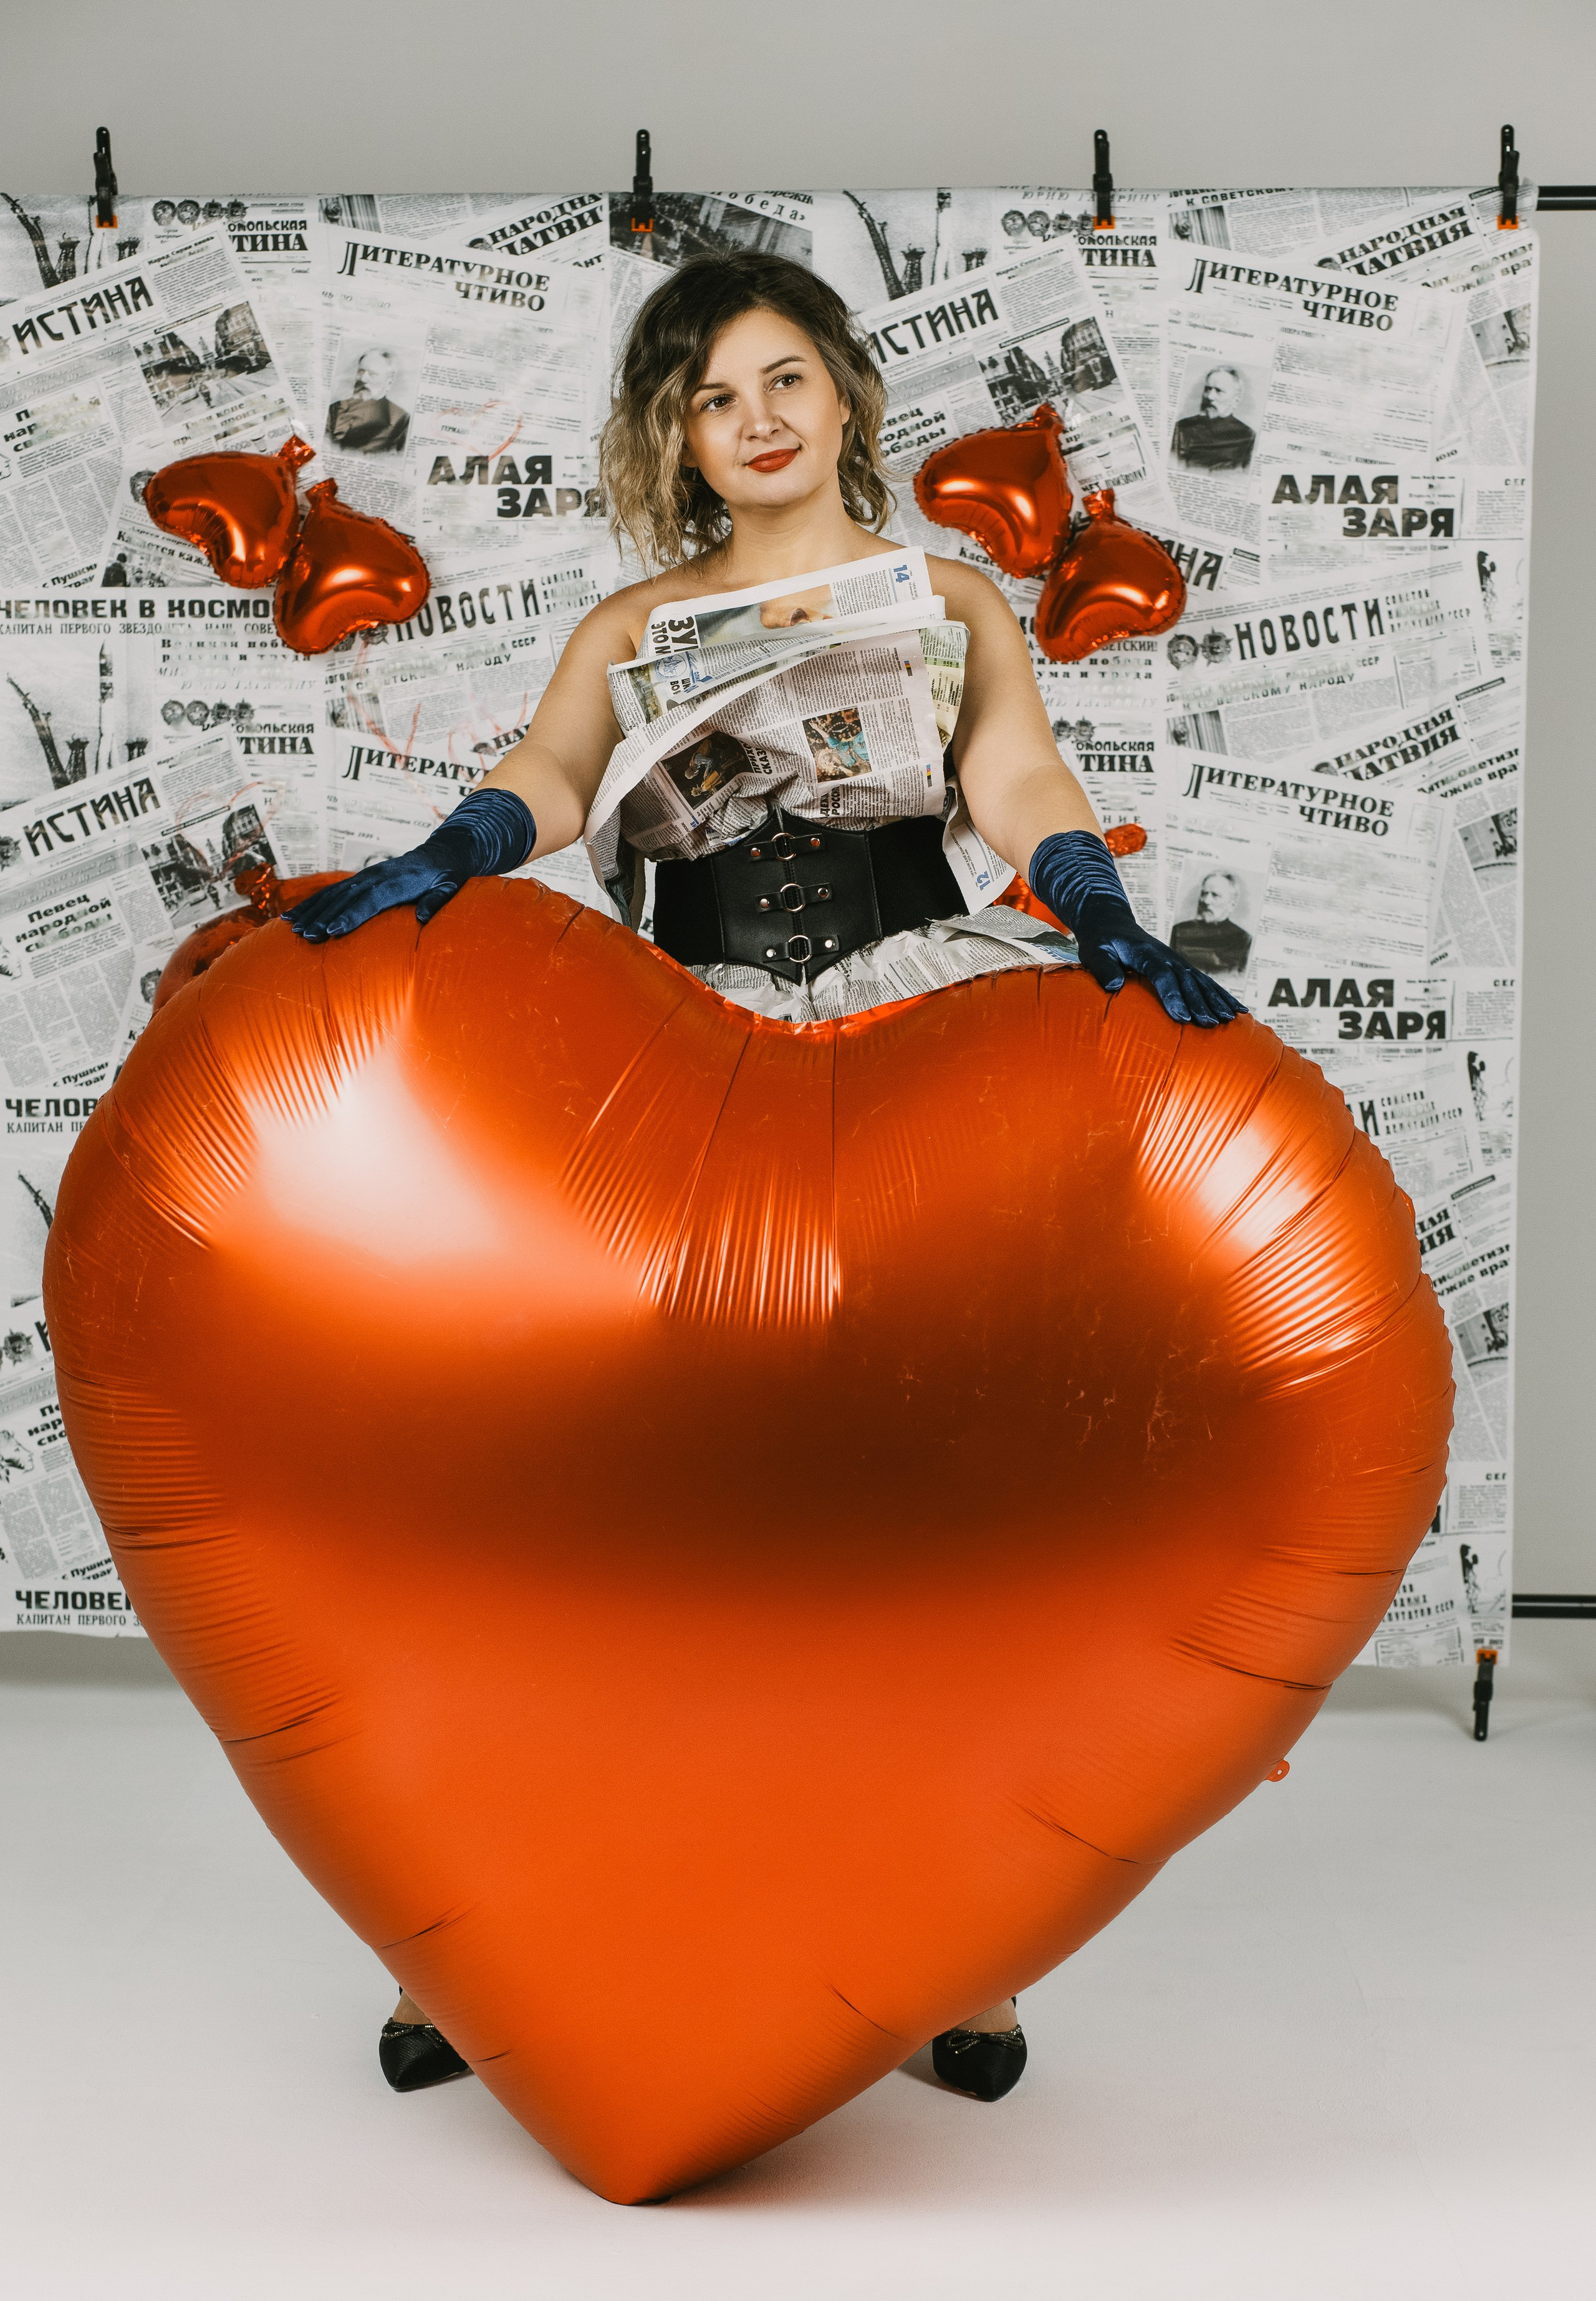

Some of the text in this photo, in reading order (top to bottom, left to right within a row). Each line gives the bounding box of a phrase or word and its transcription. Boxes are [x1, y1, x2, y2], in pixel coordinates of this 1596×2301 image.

[1334, 206, 1467, 264] НАРОДНАЯ
[337, 241, 549, 292] ЛИТЕРАТУРНОЕ
[454, 281, 545, 312] ЧТИВО
[1185, 258, 1398, 312] ЛИТЕРАТУРНОЕ
[12, 276, 153, 355] ИСТИНА
[1302, 300, 1393, 332] ЧТИВО
[427, 455, 552, 485] АЛАЯ
[1272, 475, 1399, 504] АЛАЯ
[1343, 508, 1454, 537] ЗАРЯ
[893, 564, 910, 583] 14
[139, 599, 155, 618] В
[168, 599, 276, 619] КОСМО
[60, 624, 112, 635] ПЕРВОГО
[244, 624, 278, 635] СОВЕ
[650, 620, 671, 656] ЭТО М
[1234, 598, 1386, 660] НОВОСТИ
[1333, 708, 1455, 768] НАРОДНАЯ
[342, 745, 490, 783] ЛИТЕРАТУ
[754, 746, 773, 776] СКАЗ
[1487, 761, 1519, 779] вра
[1182, 763, 1394, 817] ЛИТЕРАТУРНОЕ
[22, 778, 161, 857] ИСТИНА
[1298, 806, 1389, 837] ЧТИВО
[978, 871, 991, 891] 12
[27, 894, 90, 923] Певец
[1268, 978, 1394, 1007] АЛАЯ
[1493, 979, 1515, 987] СЕГ
[1339, 1011, 1446, 1040] ЗАРЯ
[5, 1098, 98, 1117] ЧЕЛОВ
[7, 1122, 63, 1134] КАПИТАН
[1479, 1258, 1511, 1278] вра
[27, 1419, 62, 1437] нар
[37, 1430, 67, 1446] сво
[1486, 1472, 1507, 1480] СЕГ
[17, 1614, 126, 1626] КАПИТАН ПЕРВОГО
